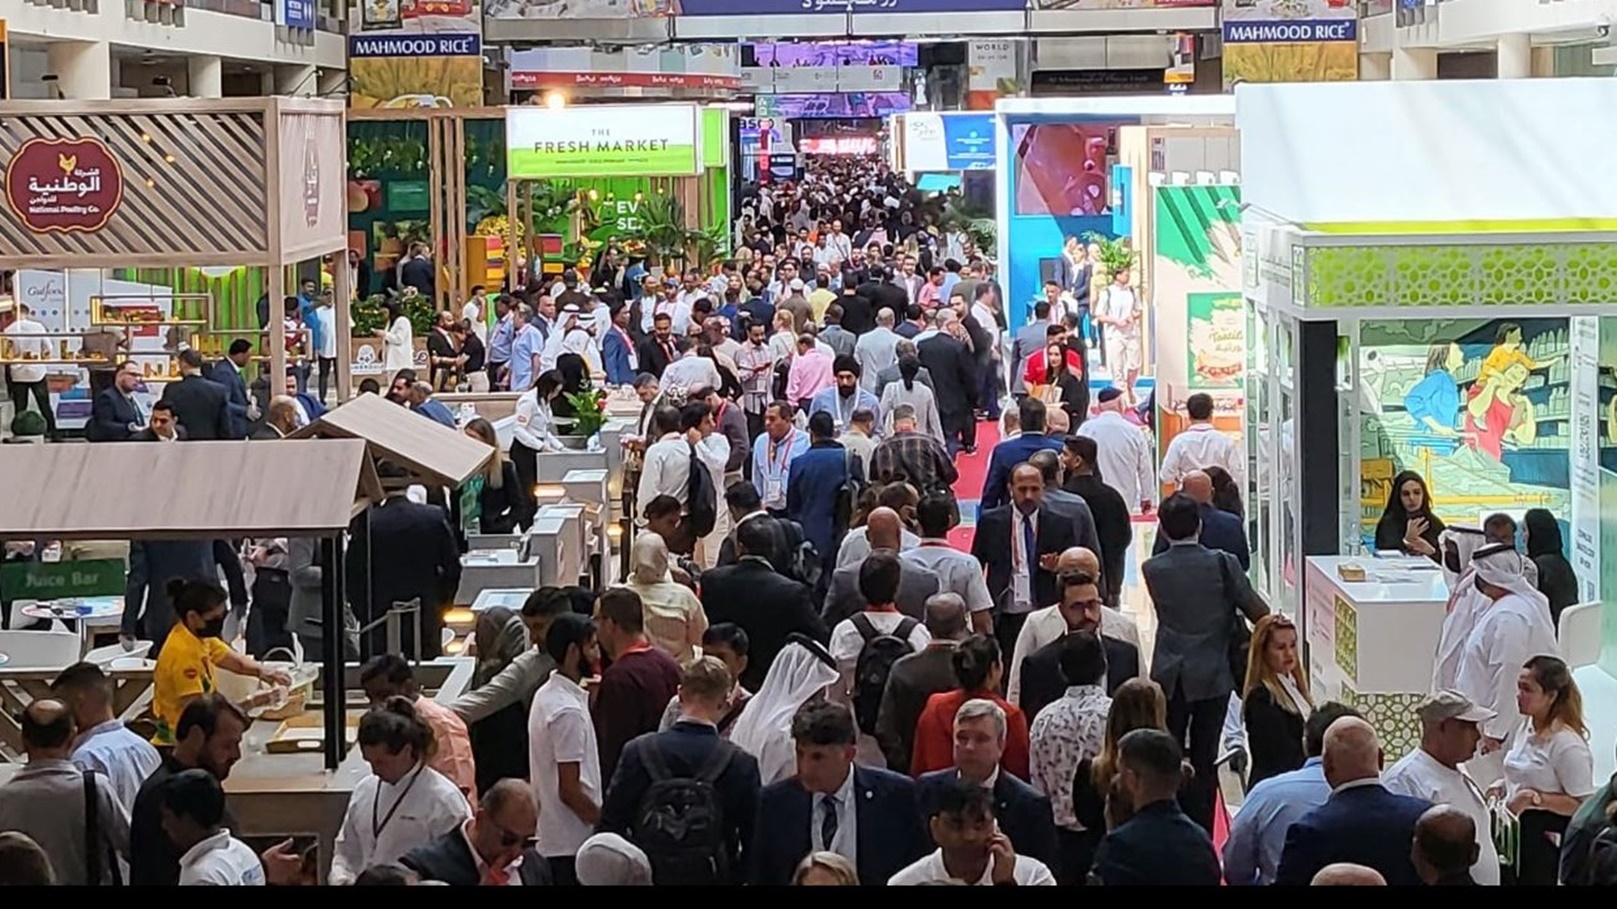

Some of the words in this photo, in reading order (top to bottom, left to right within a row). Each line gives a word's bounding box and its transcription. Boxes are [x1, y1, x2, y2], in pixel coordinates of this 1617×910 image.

[1229, 24, 1311, 40] MAHMOOD
[355, 38, 436, 54] MAHMOOD
[975, 43, 1010, 51] WORLD
[591, 128, 611, 137] THE
[534, 141, 590, 154] FRESH
[596, 138, 669, 152] MARKET
[28, 176, 101, 198] الوطنية
[28, 205, 60, 213] National
[61, 205, 87, 215] Poultry
[24, 573, 66, 588] Juice
[71, 571, 99, 586] Bar
